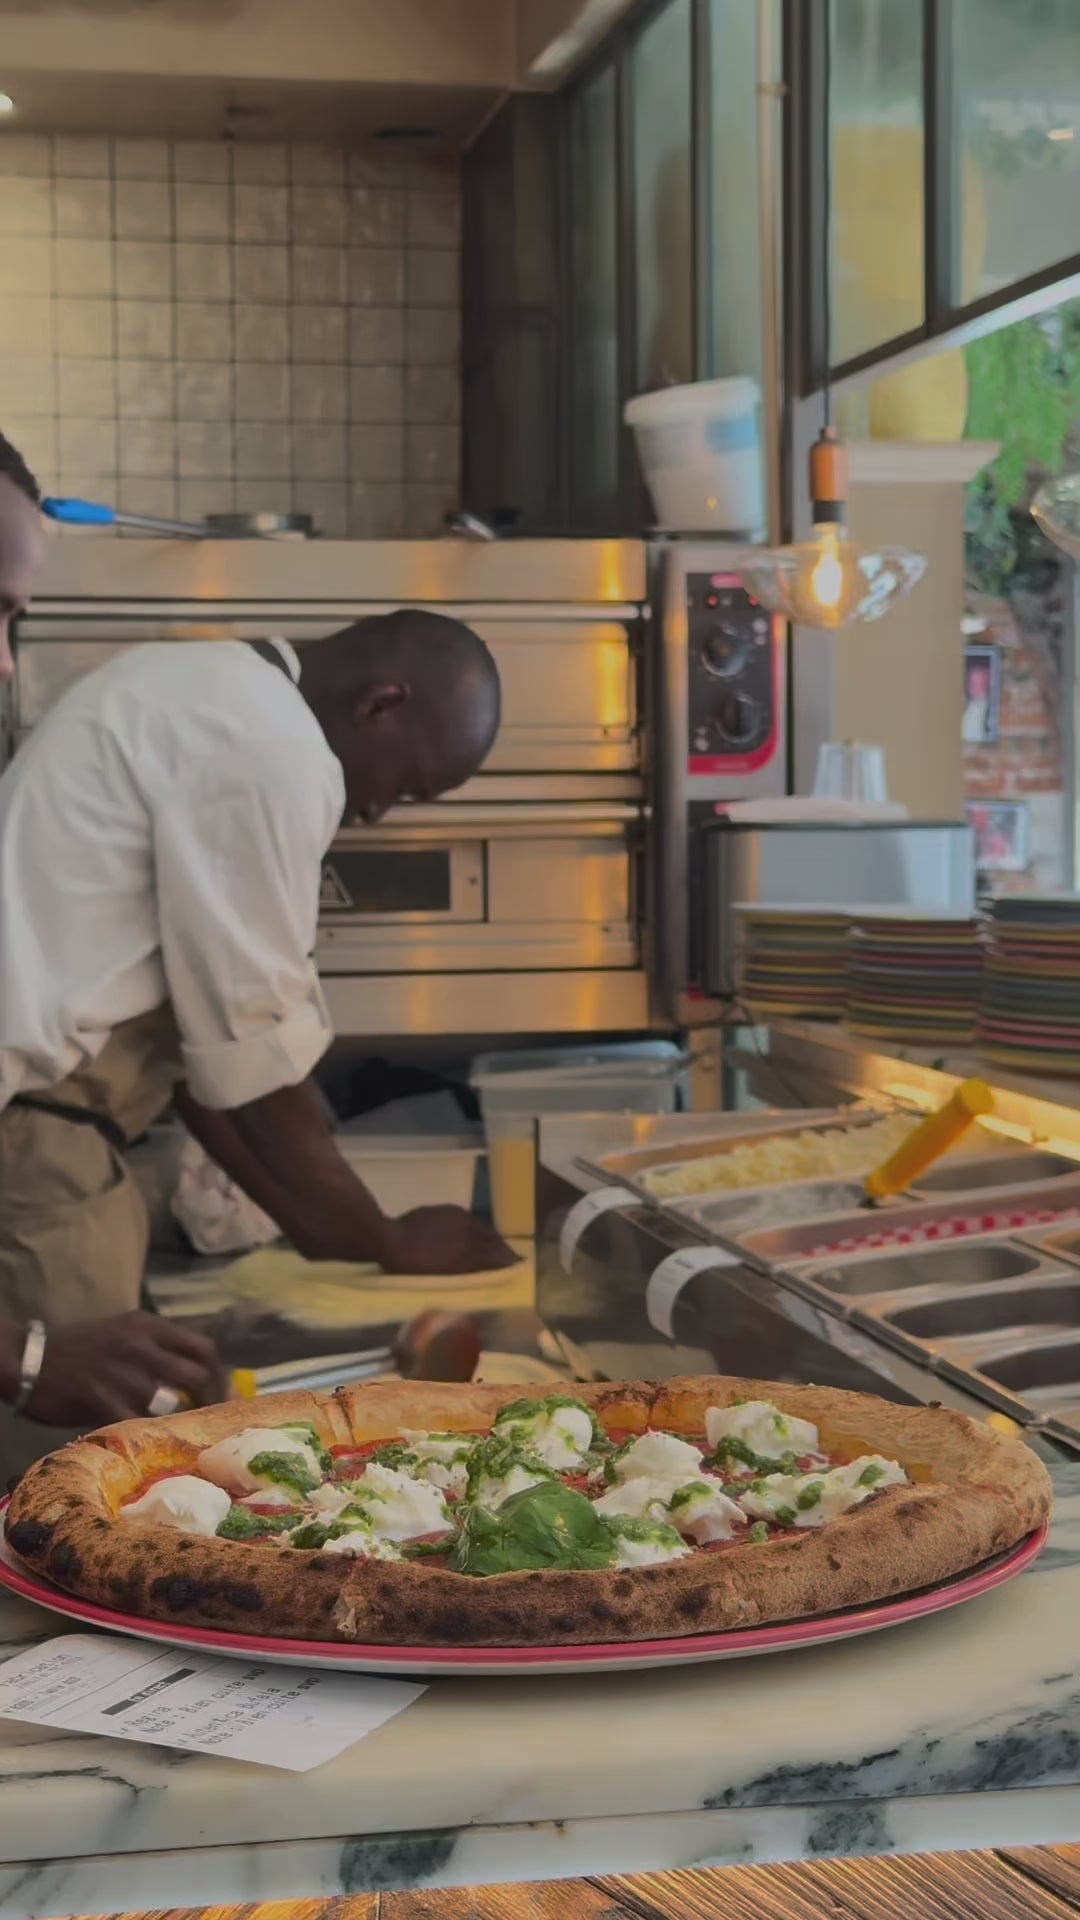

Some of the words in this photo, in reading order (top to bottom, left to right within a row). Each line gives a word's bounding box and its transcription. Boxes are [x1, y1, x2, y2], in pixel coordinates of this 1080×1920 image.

[211, 1681, 245, 1699] cuite
[242, 1668, 264, 1681] svp
[267, 1691, 300, 1709] cuite
[297, 1677, 320, 1690] svp
